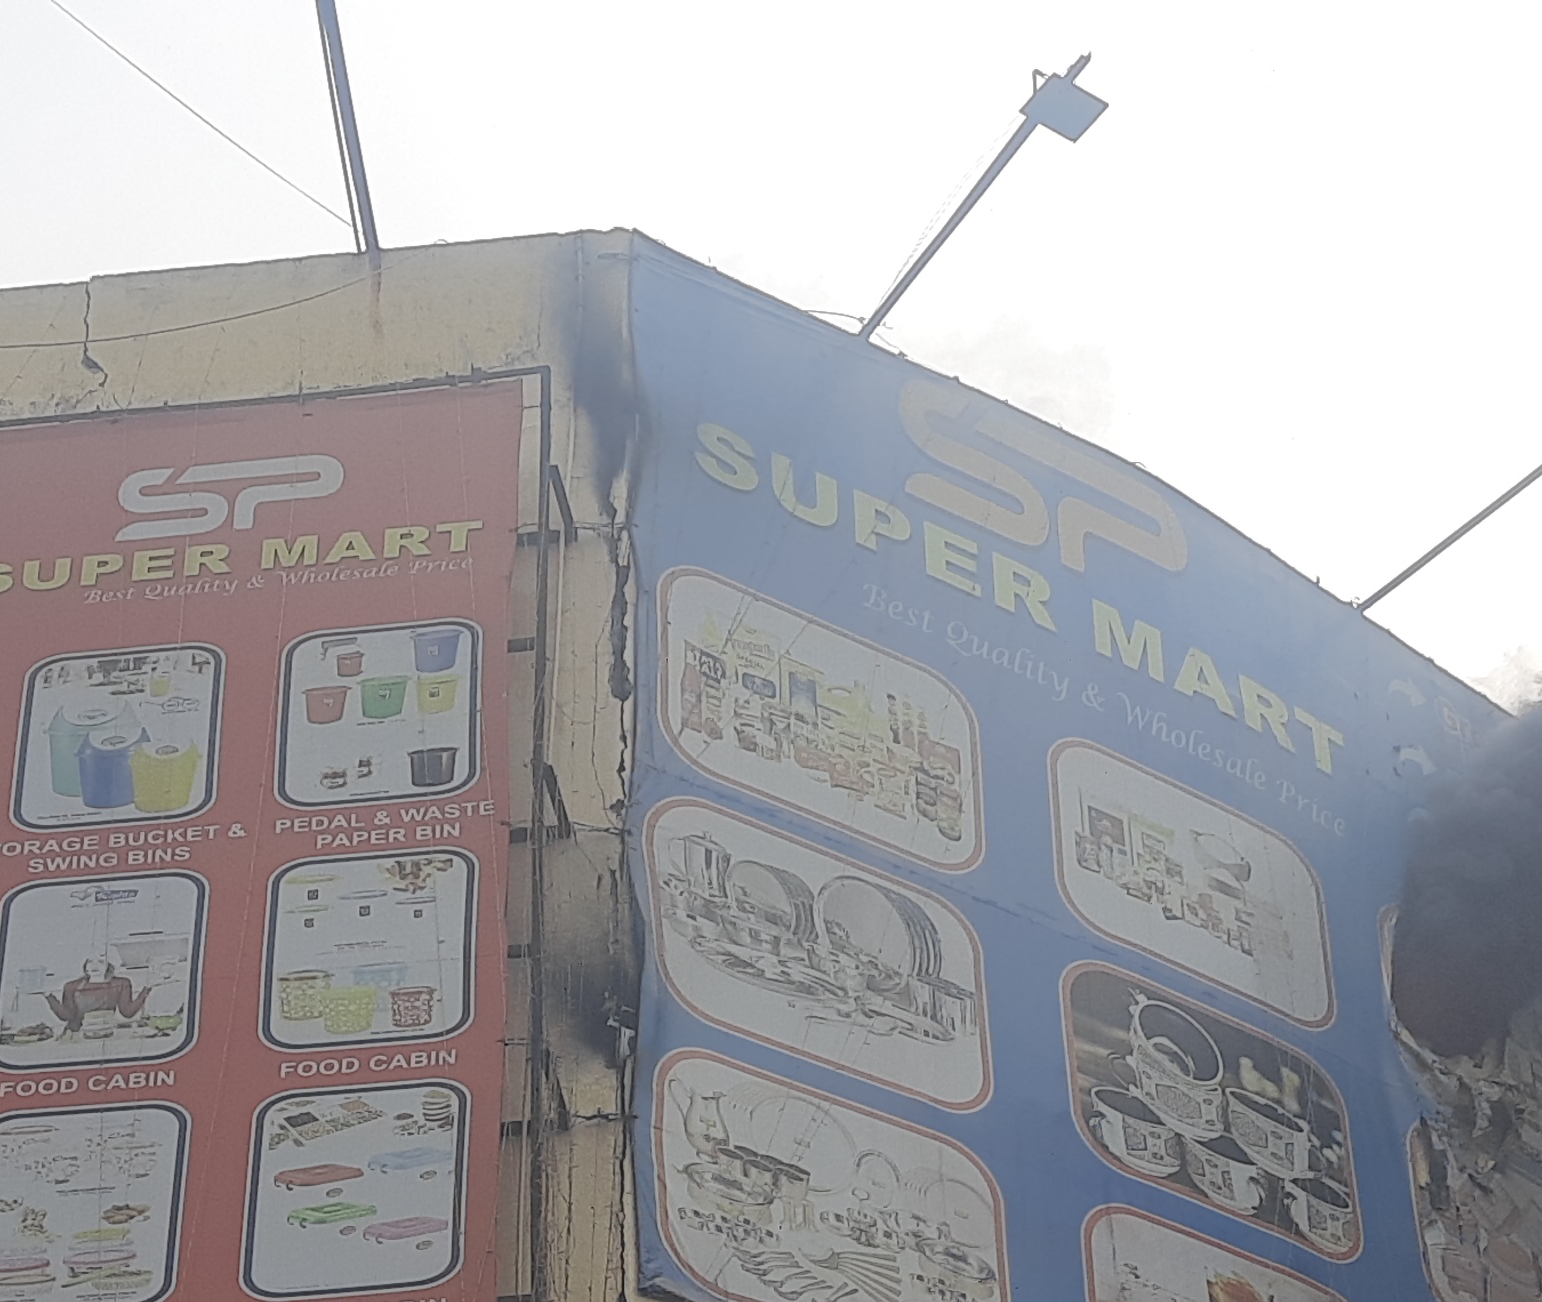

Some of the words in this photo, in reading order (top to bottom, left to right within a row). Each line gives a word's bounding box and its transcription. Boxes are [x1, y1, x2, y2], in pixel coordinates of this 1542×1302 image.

[900, 378, 1187, 572] SP
[115, 454, 345, 542] SP
[260, 520, 484, 570] MART
[84, 586, 135, 605] Best
[143, 576, 238, 601] Quality
[246, 573, 265, 589] &
[275, 562, 399, 586] Wholesale
[407, 554, 475, 576] Price
[694, 422, 1058, 632] SUPER
[1091, 598, 1345, 776] MART
[862, 580, 934, 635] Best
[946, 619, 1069, 697] Quality
[1081, 680, 1108, 713] &
[1115, 691, 1268, 792] Wholesale
[1276, 779, 1349, 838] Price
[108, 825, 220, 846] BUCKET
[227, 823, 247, 838] &
[275, 813, 366, 833] PEDAL
[375, 810, 392, 825] &
[400, 801, 496, 822] WASTE
[317, 829, 408, 849] PAPER
[417, 823, 461, 841] BIN
[28, 852, 119, 873] SWING
[127, 846, 193, 865] BINS
[0, 1076, 79, 1098] FOOD
[87, 1070, 176, 1091] CABIN
[280, 1057, 360, 1079] FOOD
[368, 1049, 457, 1071] CABIN
